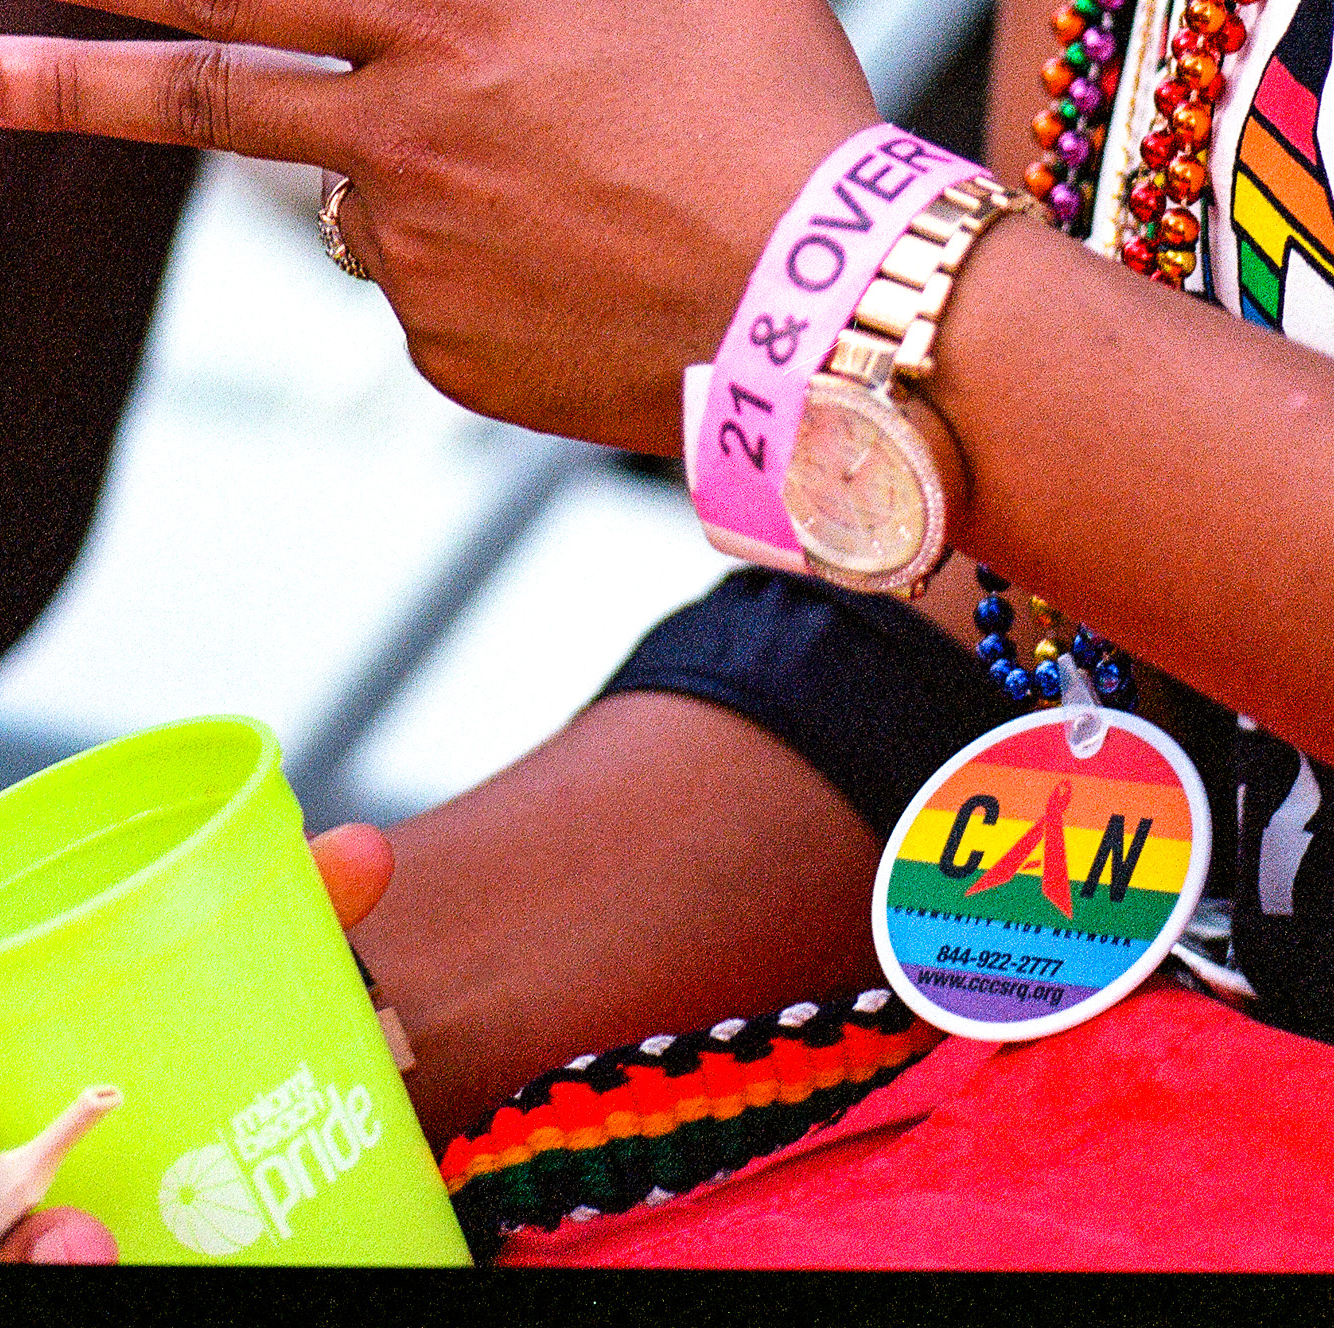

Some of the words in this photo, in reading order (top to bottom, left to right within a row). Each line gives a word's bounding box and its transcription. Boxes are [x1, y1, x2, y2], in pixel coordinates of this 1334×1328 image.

[718, 381, 774, 473] 21
[748, 312, 809, 366] &
[785, 137, 951, 292] OVER
[937, 779, 1155, 920] CAN
[917, 969, 1066, 1007] www.cccsrq.org
[935, 944, 1065, 978] 844-922-2777
[253, 1082, 383, 1240] pride
